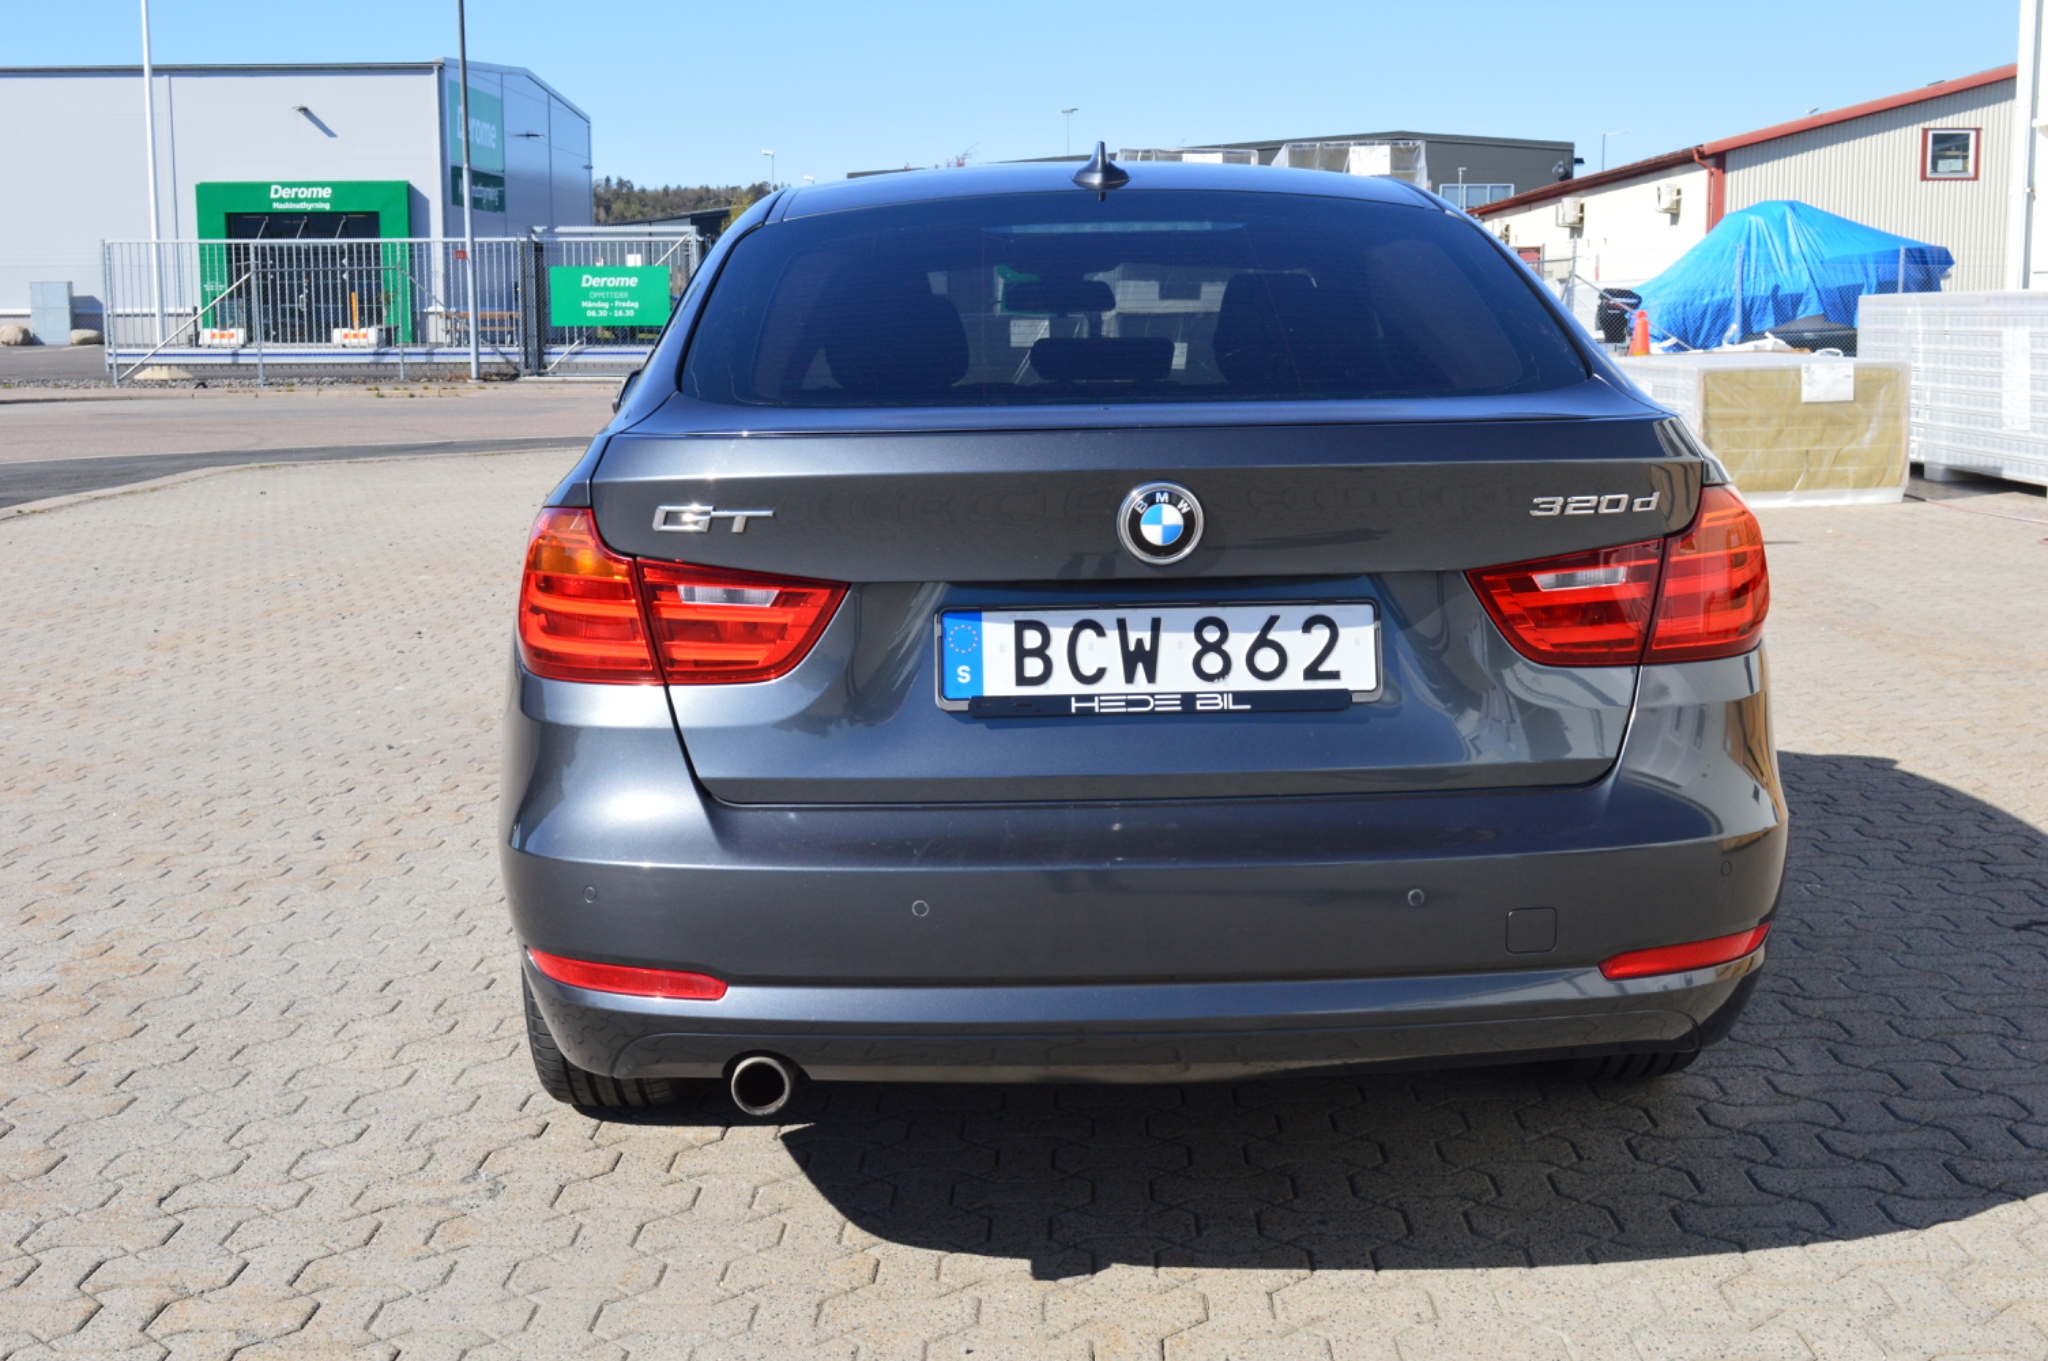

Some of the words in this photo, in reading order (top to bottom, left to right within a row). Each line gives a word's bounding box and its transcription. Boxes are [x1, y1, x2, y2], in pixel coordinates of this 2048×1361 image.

[457, 105, 497, 149] Drome
[270, 185, 332, 198] Derome
[272, 202, 330, 210] Maskinuthyrning
[581, 275, 638, 287] Derome
[1134, 492, 1190, 514] BMW
[652, 504, 774, 532] GT
[1013, 617, 1162, 687] BCW
[1192, 614, 1341, 683] 862
[956, 665, 971, 683] S
[1071, 694, 1182, 713] HEDE
[1196, 693, 1251, 710] BIL
